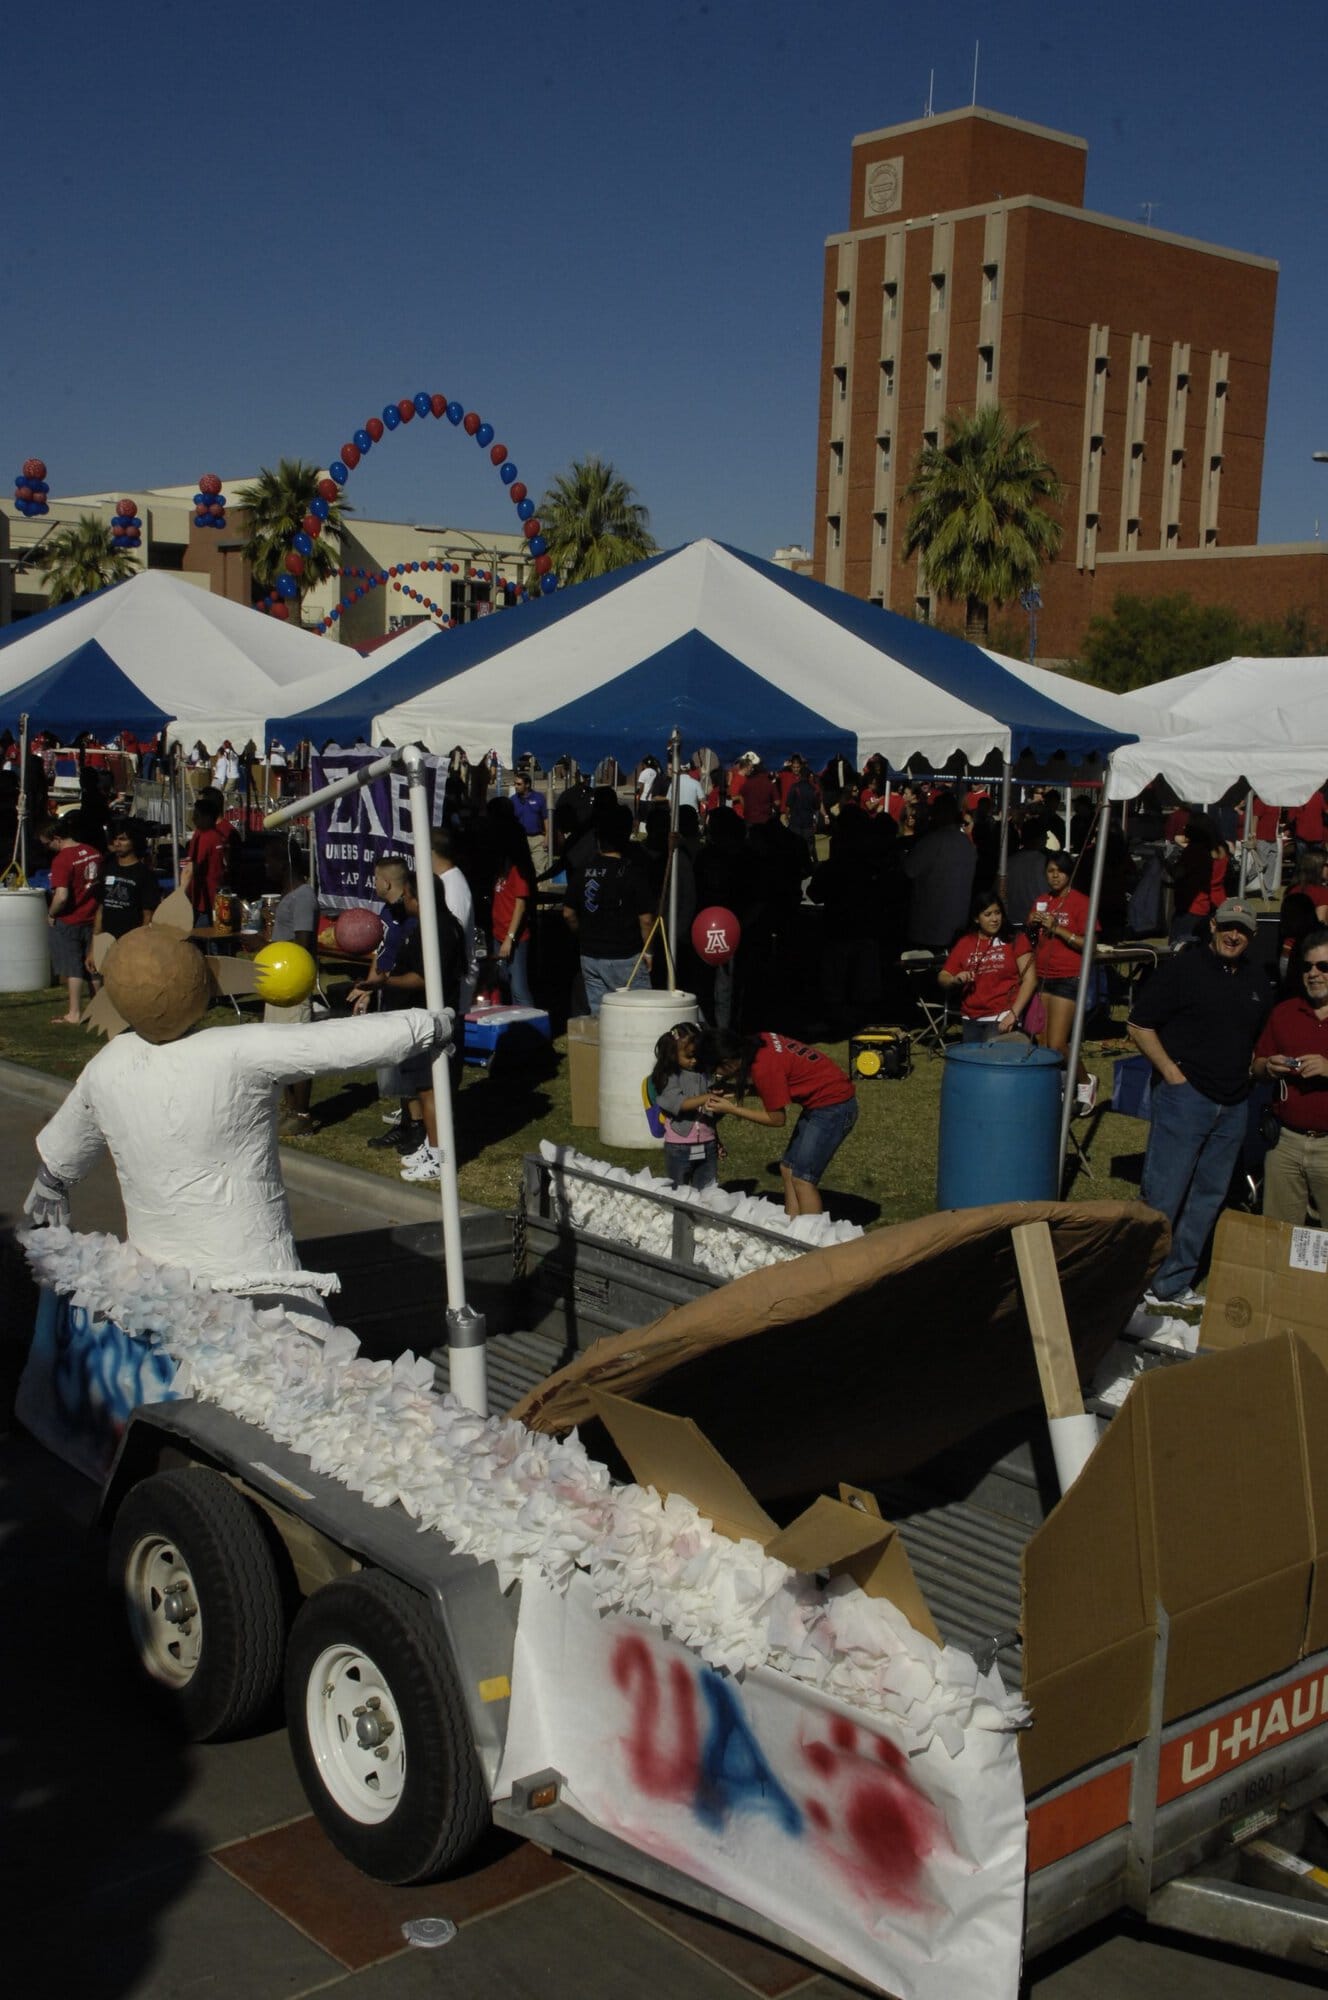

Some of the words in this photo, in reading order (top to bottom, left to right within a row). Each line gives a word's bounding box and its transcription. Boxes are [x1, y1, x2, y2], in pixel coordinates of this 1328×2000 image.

[363, 848, 375, 863] OF
[704, 929, 730, 954] A
[611, 1635, 803, 1837] UA
[1181, 1674, 1328, 1785] U-HAU
